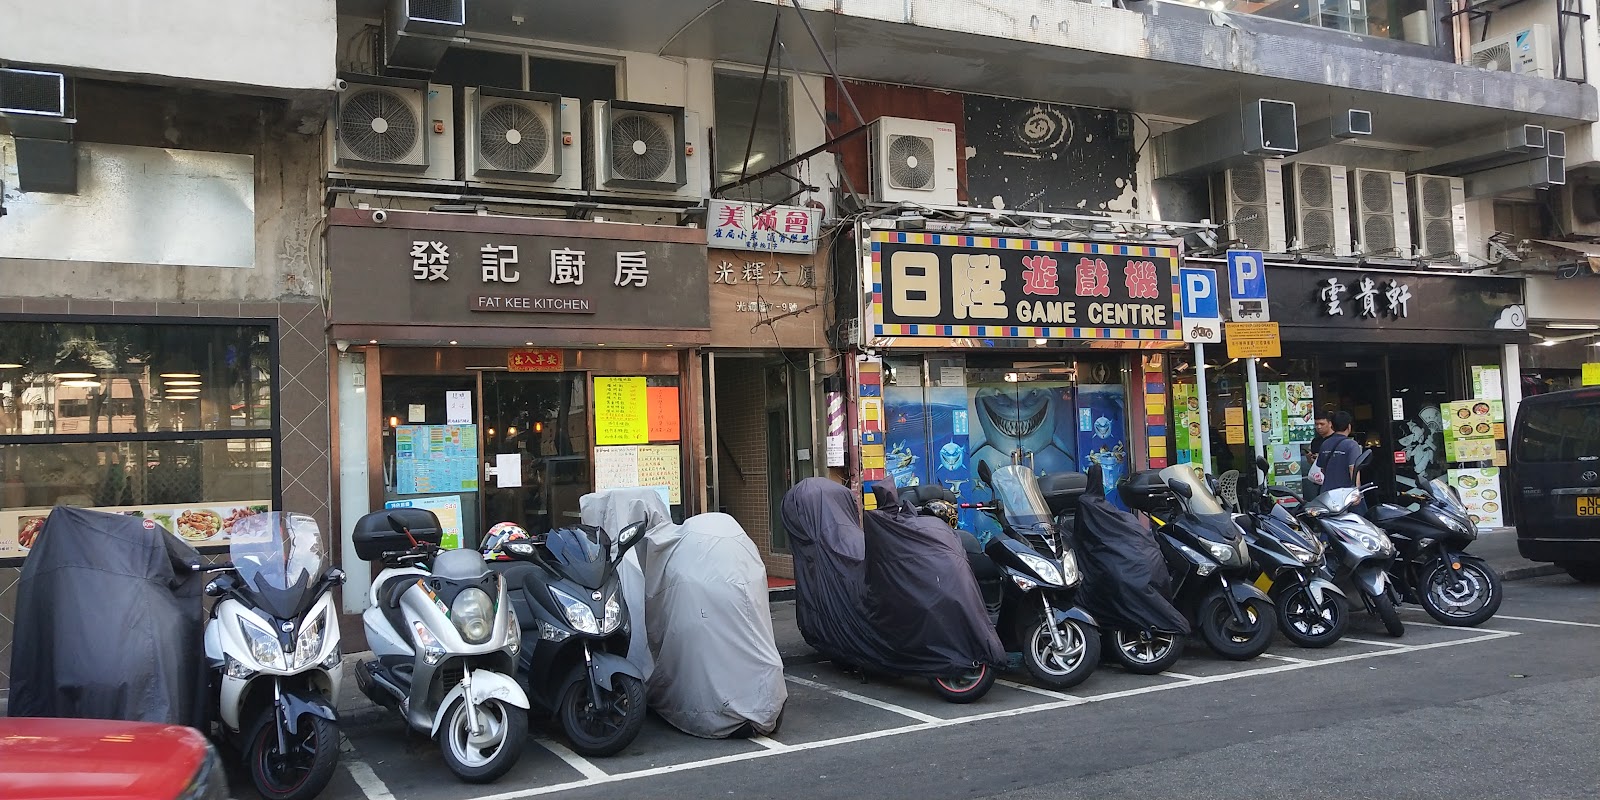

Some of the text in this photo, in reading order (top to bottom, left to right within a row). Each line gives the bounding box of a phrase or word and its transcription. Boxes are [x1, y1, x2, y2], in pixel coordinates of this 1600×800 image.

[718, 205, 809, 234] 美滿會
[409, 240, 649, 288] 發記廚房
[714, 260, 816, 289] 光輝大廈
[1022, 255, 1160, 299] 遊戲機
[1236, 255, 1258, 294] P
[478, 296, 589, 310] FAT KEE KITCHEN
[1187, 274, 1211, 314] P
[1321, 277, 1413, 318] 雲貴軒
[1016, 300, 1167, 326] GAME CENTRE
[514, 353, 558, 366] 出入平安
